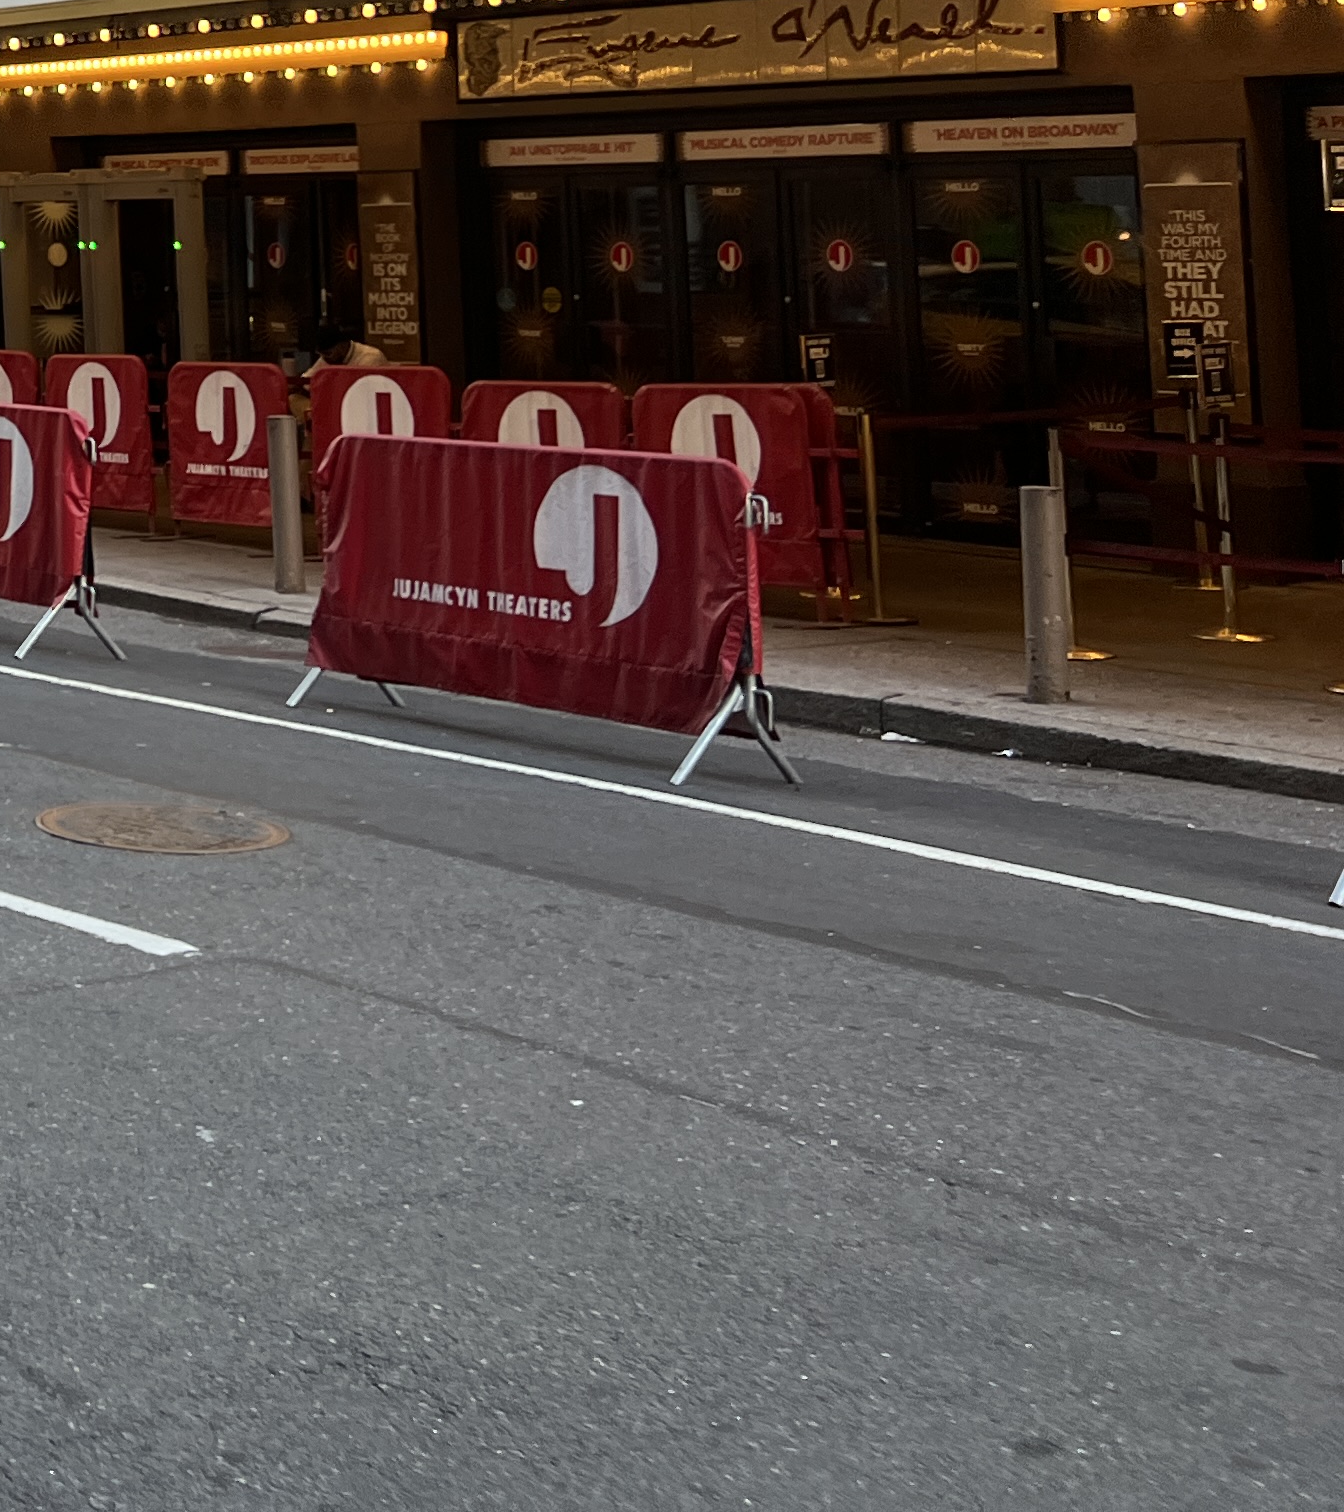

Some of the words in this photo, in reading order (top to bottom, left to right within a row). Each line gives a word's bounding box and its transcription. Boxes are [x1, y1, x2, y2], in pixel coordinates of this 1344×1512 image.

[1001, 126, 1024, 139] ON
[749, 134, 804, 149] COMEDY
[945, 182, 980, 192] HELLO
[1161, 223, 1195, 235] WAS
[1197, 223, 1220, 235] MY
[1161, 236, 1222, 248] FOURTH
[1158, 249, 1192, 261] TIME
[1194, 249, 1228, 261] AND
[373, 264, 385, 276] IS
[387, 263, 407, 276] ON
[1162, 262, 1224, 279] THEY
[380, 277, 401, 290] ITS
[1164, 281, 1225, 299] STILL
[368, 292, 415, 305] MARCH
[376, 307, 408, 320] INTO
[1170, 300, 1220, 318] HAD
[1089, 420, 1126, 432] HELLO
[963, 502, 999, 514] HELLO
[392, 576, 480, 610] JUJAMCYN
[487, 589, 573, 622] THEATERS
